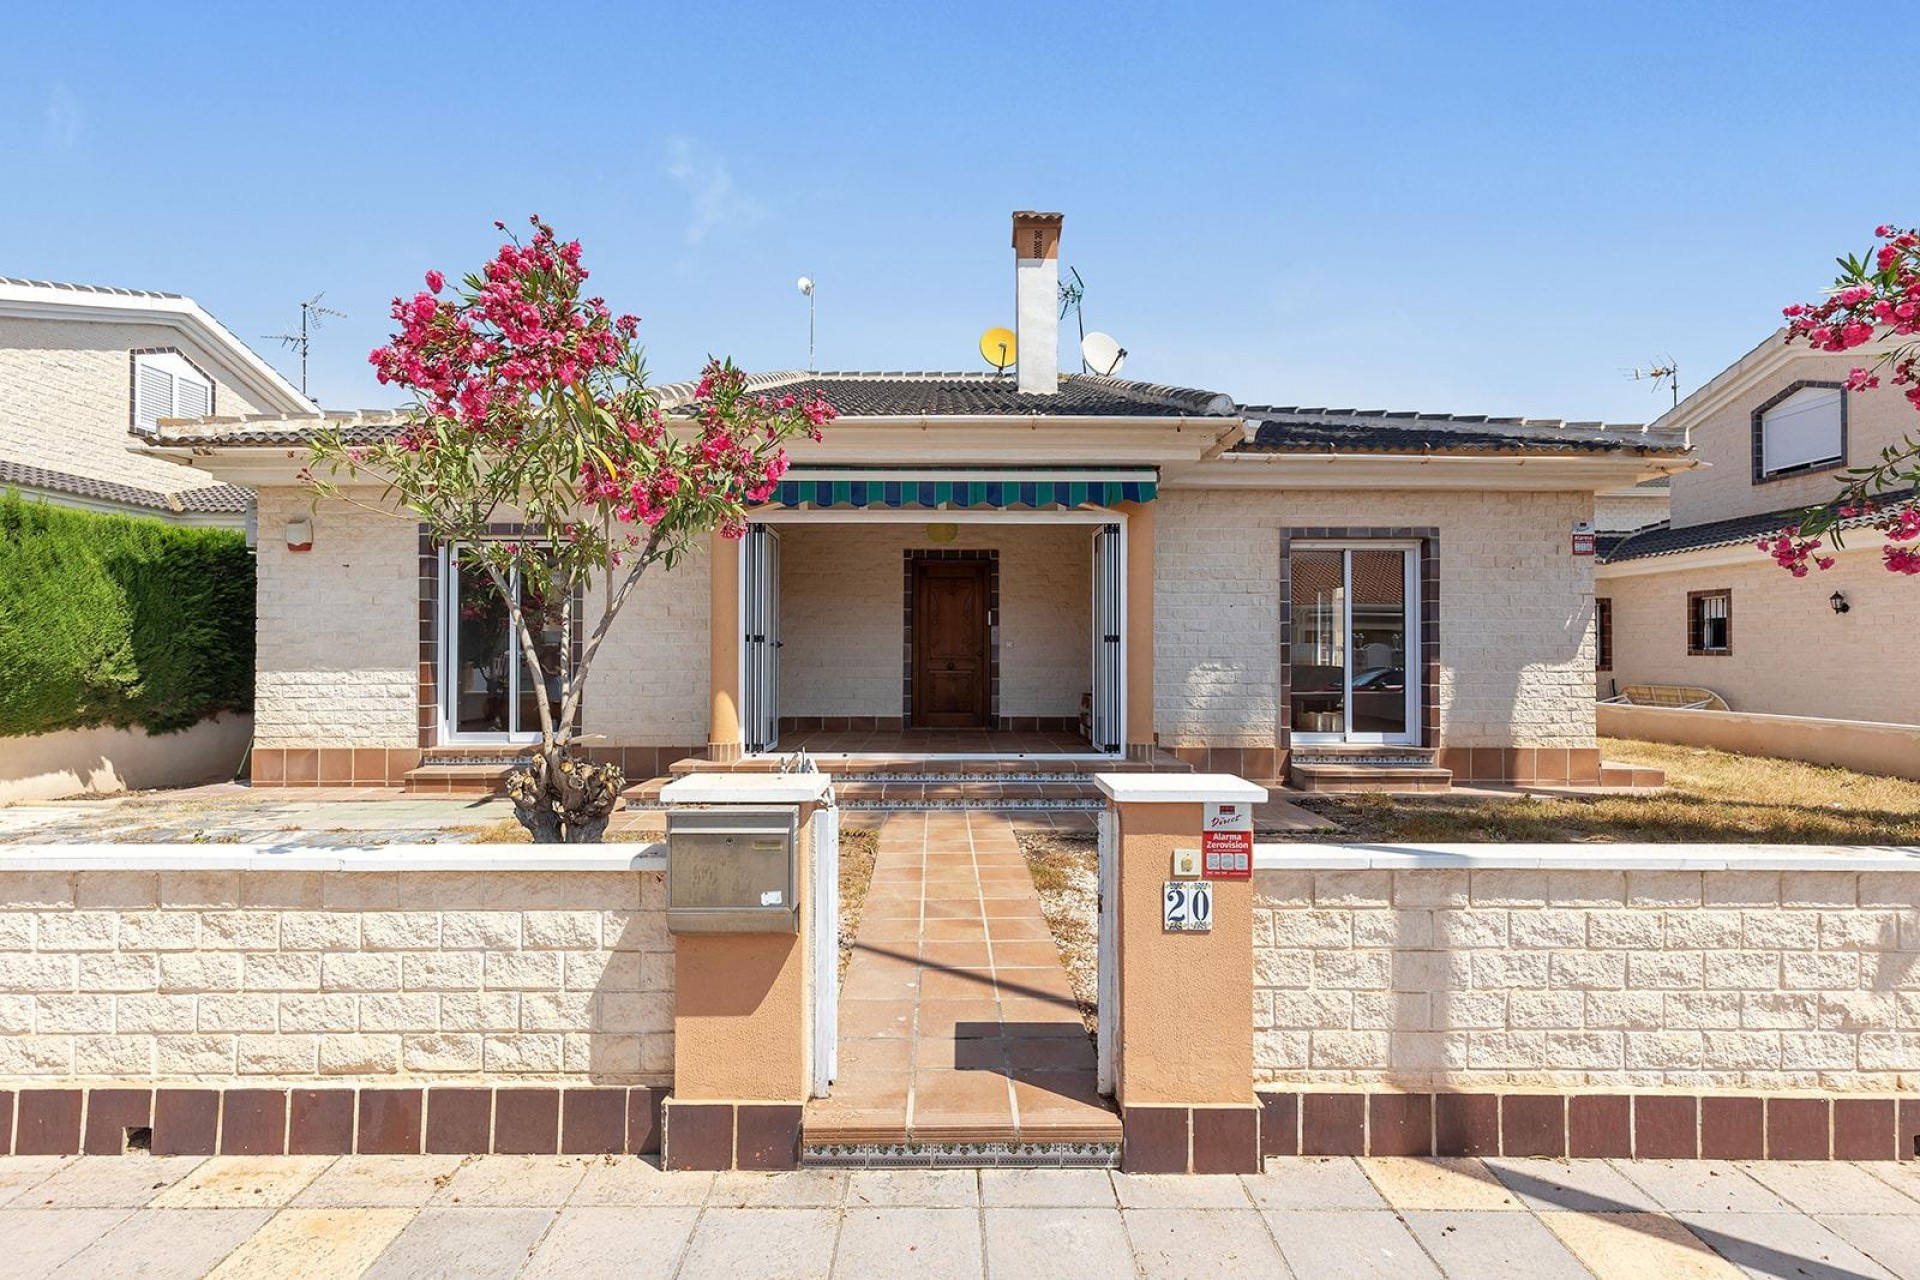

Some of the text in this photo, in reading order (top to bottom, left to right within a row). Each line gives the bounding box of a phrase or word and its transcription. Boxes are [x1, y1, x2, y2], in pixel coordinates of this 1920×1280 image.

[1212, 833, 1242, 841] Alarma
[1206, 841, 1248, 849] Zerovision
[1167, 890, 1209, 921] 20
